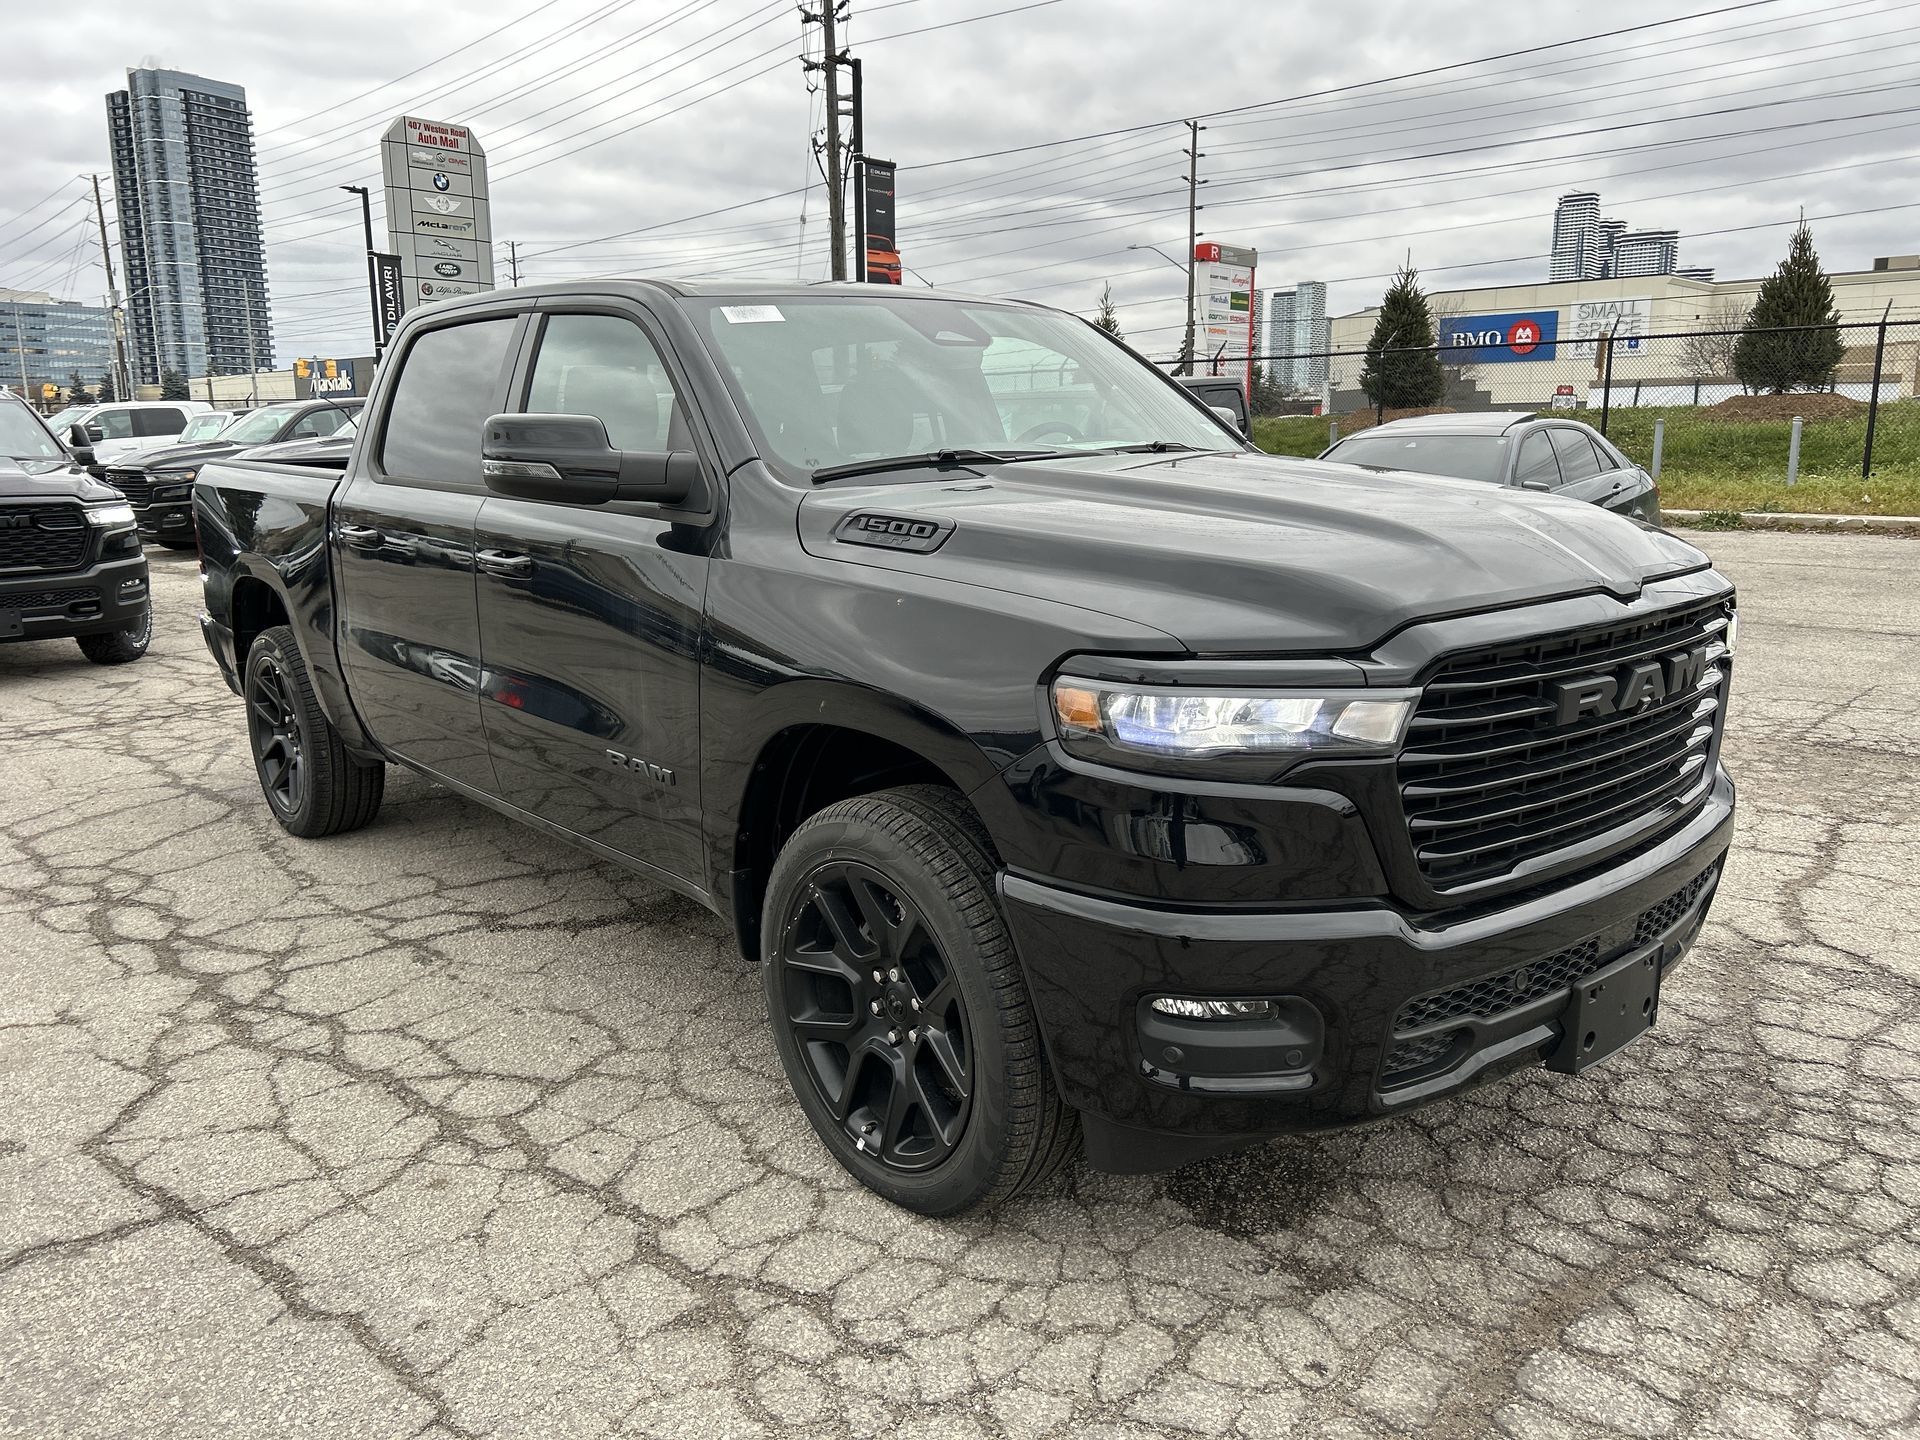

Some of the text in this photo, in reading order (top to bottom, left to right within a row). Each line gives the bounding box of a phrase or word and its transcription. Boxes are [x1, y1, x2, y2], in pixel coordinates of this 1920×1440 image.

[408, 120, 467, 138] 407 Weston Road
[418, 132, 459, 149] Auto Mall
[448, 158, 468, 166] GMC
[417, 221, 466, 232] McLaren
[1211, 245, 1219, 258] R
[383, 265, 396, 321] DILAWRI
[1578, 301, 1642, 319] SMALL
[1576, 319, 1641, 337] SPACE
[1452, 330, 1501, 346] BMO
[858, 517, 934, 538] 1500
[1556, 645, 1706, 726] RAM
[606, 748, 676, 786] RAM
